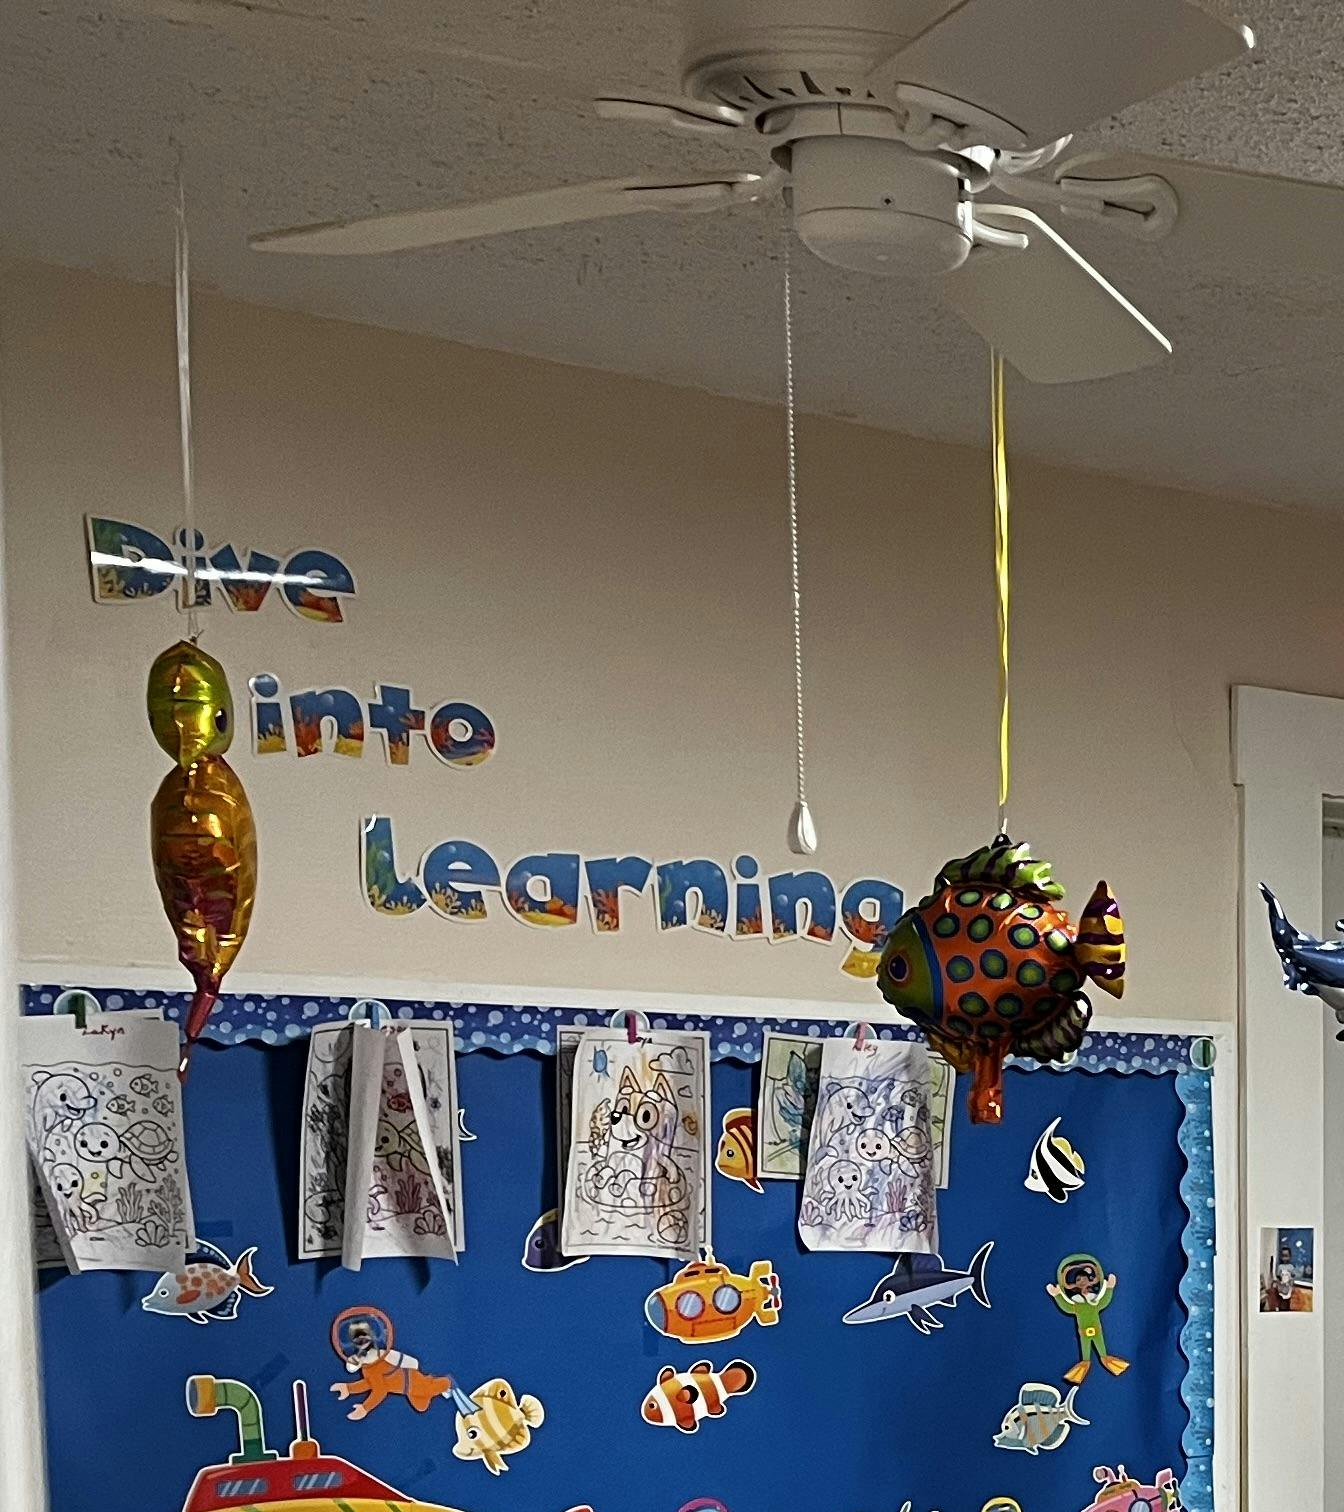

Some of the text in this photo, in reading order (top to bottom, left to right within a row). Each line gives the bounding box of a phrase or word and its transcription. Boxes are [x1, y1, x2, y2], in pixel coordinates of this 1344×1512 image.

[88, 514, 355, 622] Dive
[250, 673, 496, 766] into
[359, 817, 902, 977] Learning
